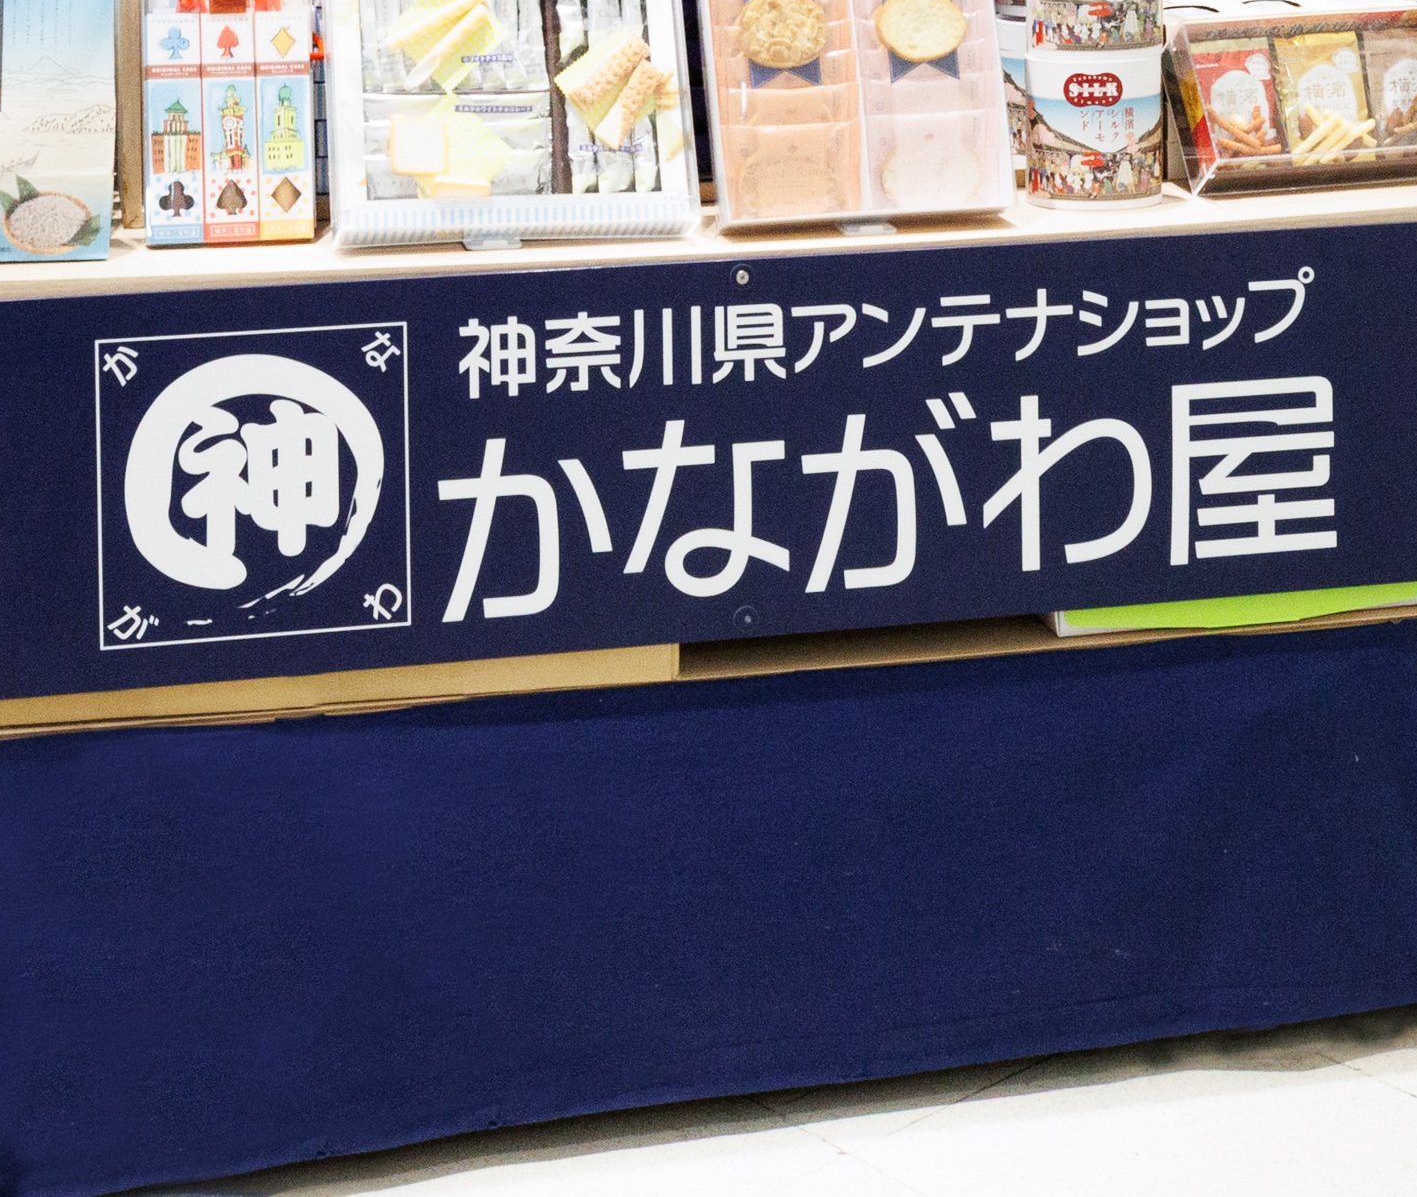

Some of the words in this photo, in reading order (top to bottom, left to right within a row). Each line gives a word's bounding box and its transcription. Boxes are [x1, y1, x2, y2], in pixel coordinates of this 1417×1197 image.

[1068, 82, 1120, 97] SILK
[1304, 82, 1346, 100] 横濱
[458, 265, 1316, 398] 神奈川県アンテナショップ
[102, 343, 140, 389] か
[439, 375, 1339, 623] かながわ屋
[108, 602, 162, 644] が
